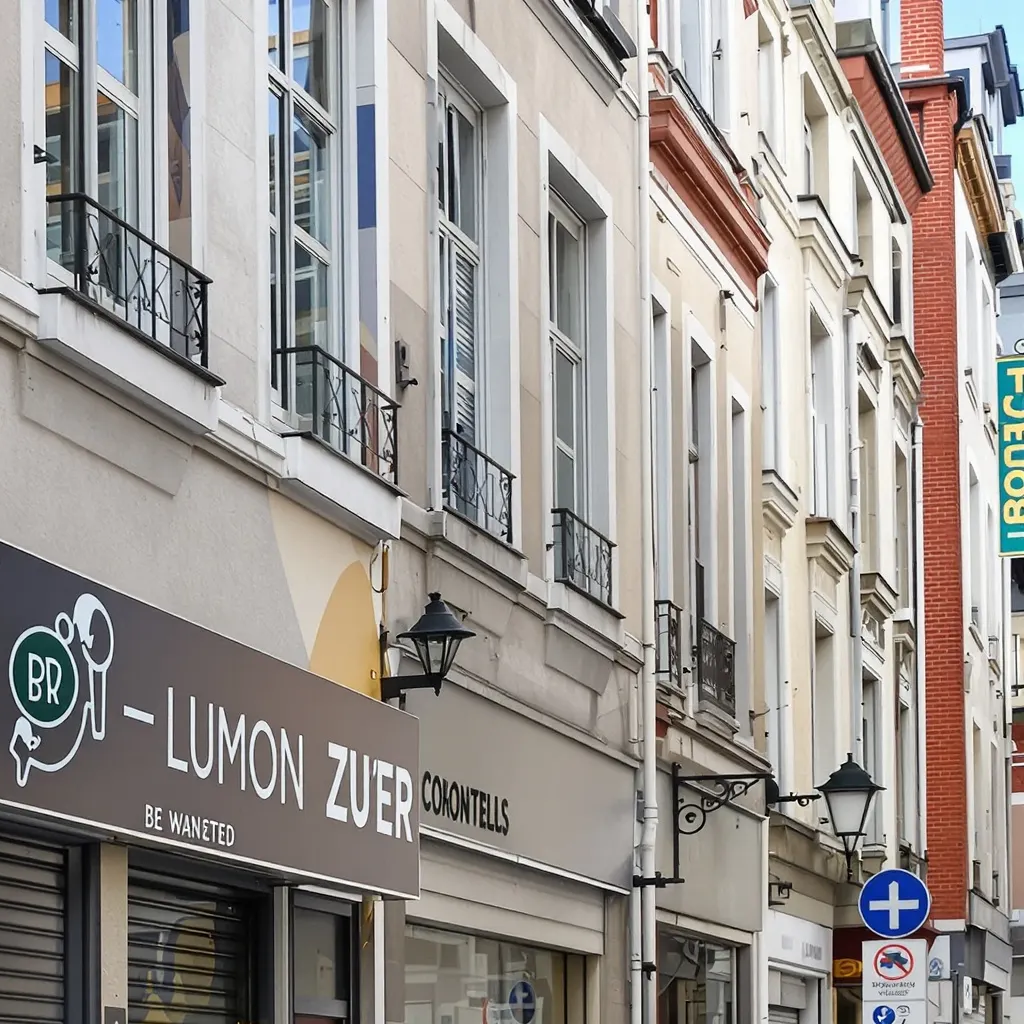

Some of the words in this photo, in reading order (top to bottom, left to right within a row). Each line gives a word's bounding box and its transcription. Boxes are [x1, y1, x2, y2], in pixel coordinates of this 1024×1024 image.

[28, 652, 62, 705] BR
[167, 686, 304, 811] LUMON
[145, 803, 163, 831] BE
